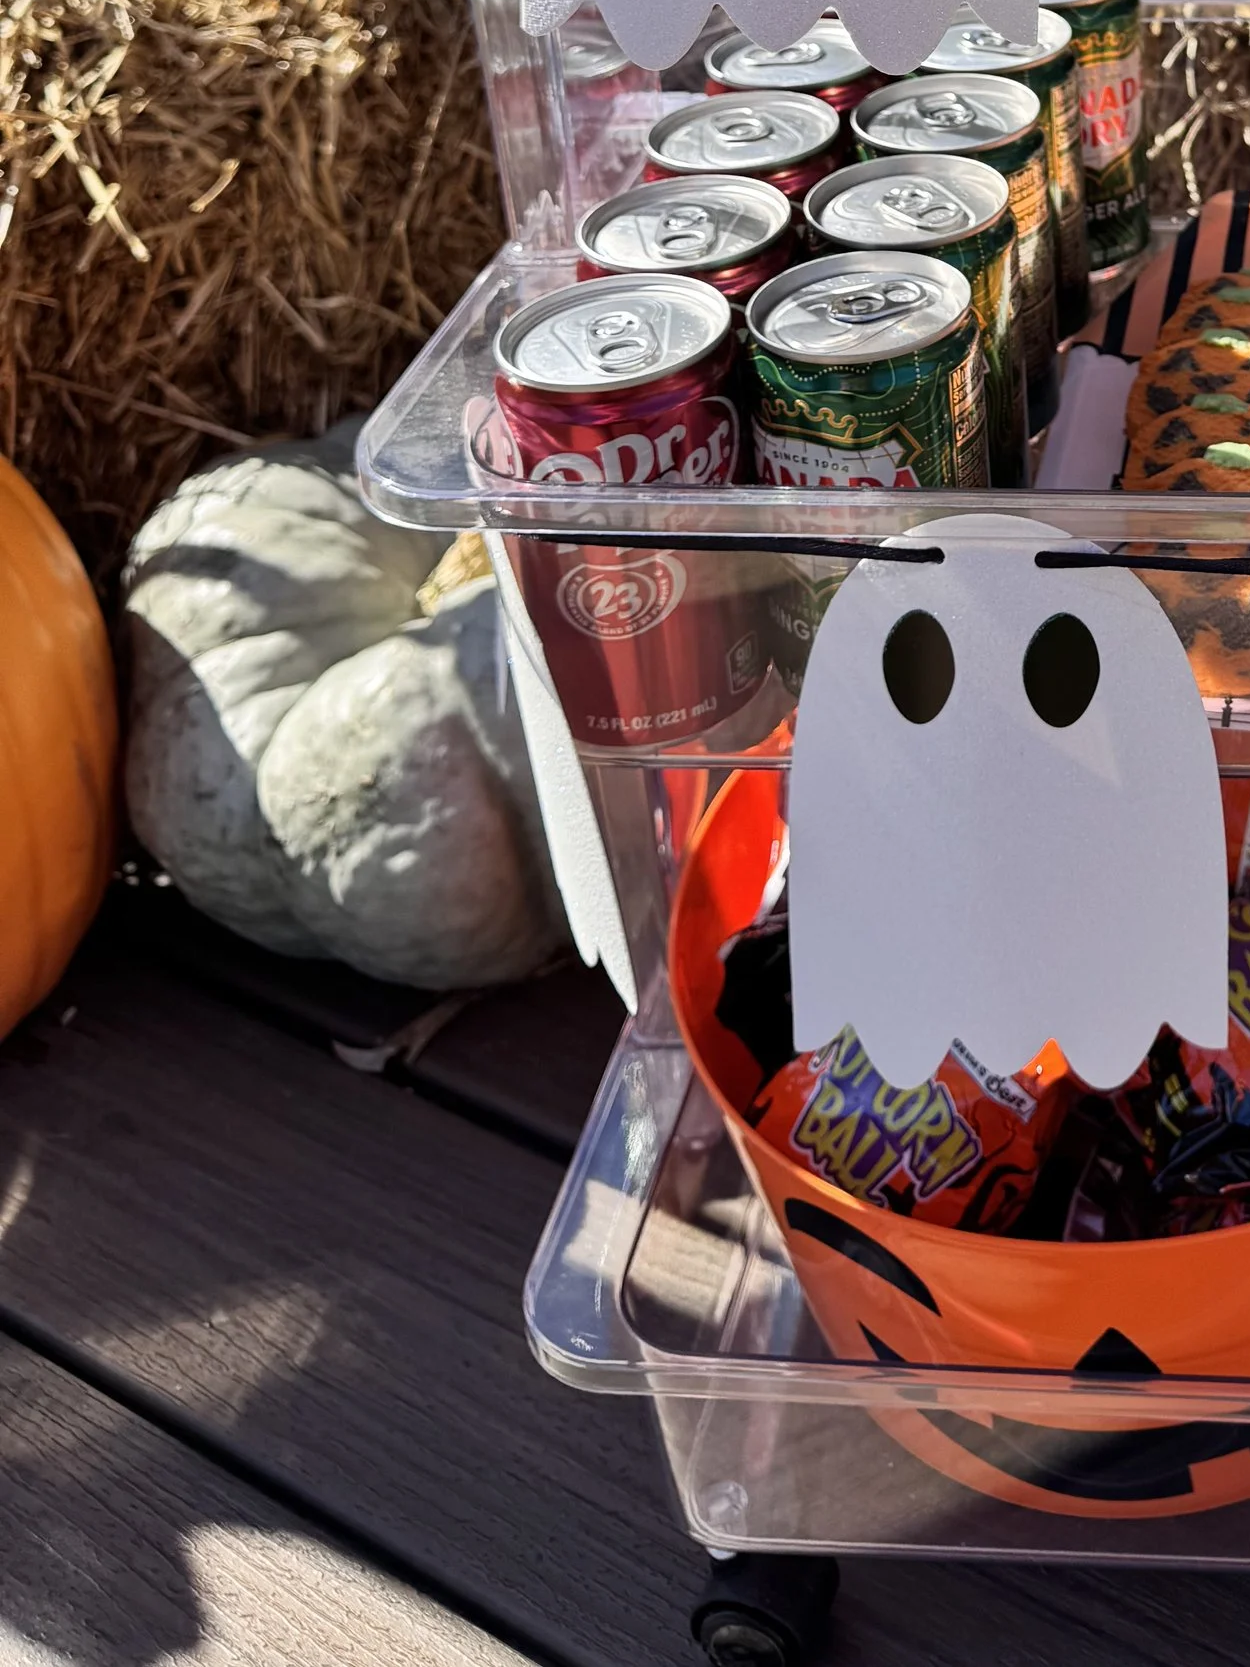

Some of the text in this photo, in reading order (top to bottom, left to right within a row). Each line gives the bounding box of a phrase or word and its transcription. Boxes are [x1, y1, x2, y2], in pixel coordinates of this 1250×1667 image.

[597, 423, 687, 484] Dr
[771, 450, 850, 474] SINCE 1904
[591, 581, 643, 621] 23
[586, 715, 610, 731] 7.5
[611, 716, 630, 732] FL
[631, 715, 653, 731] OZ
[655, 707, 688, 729] (221
